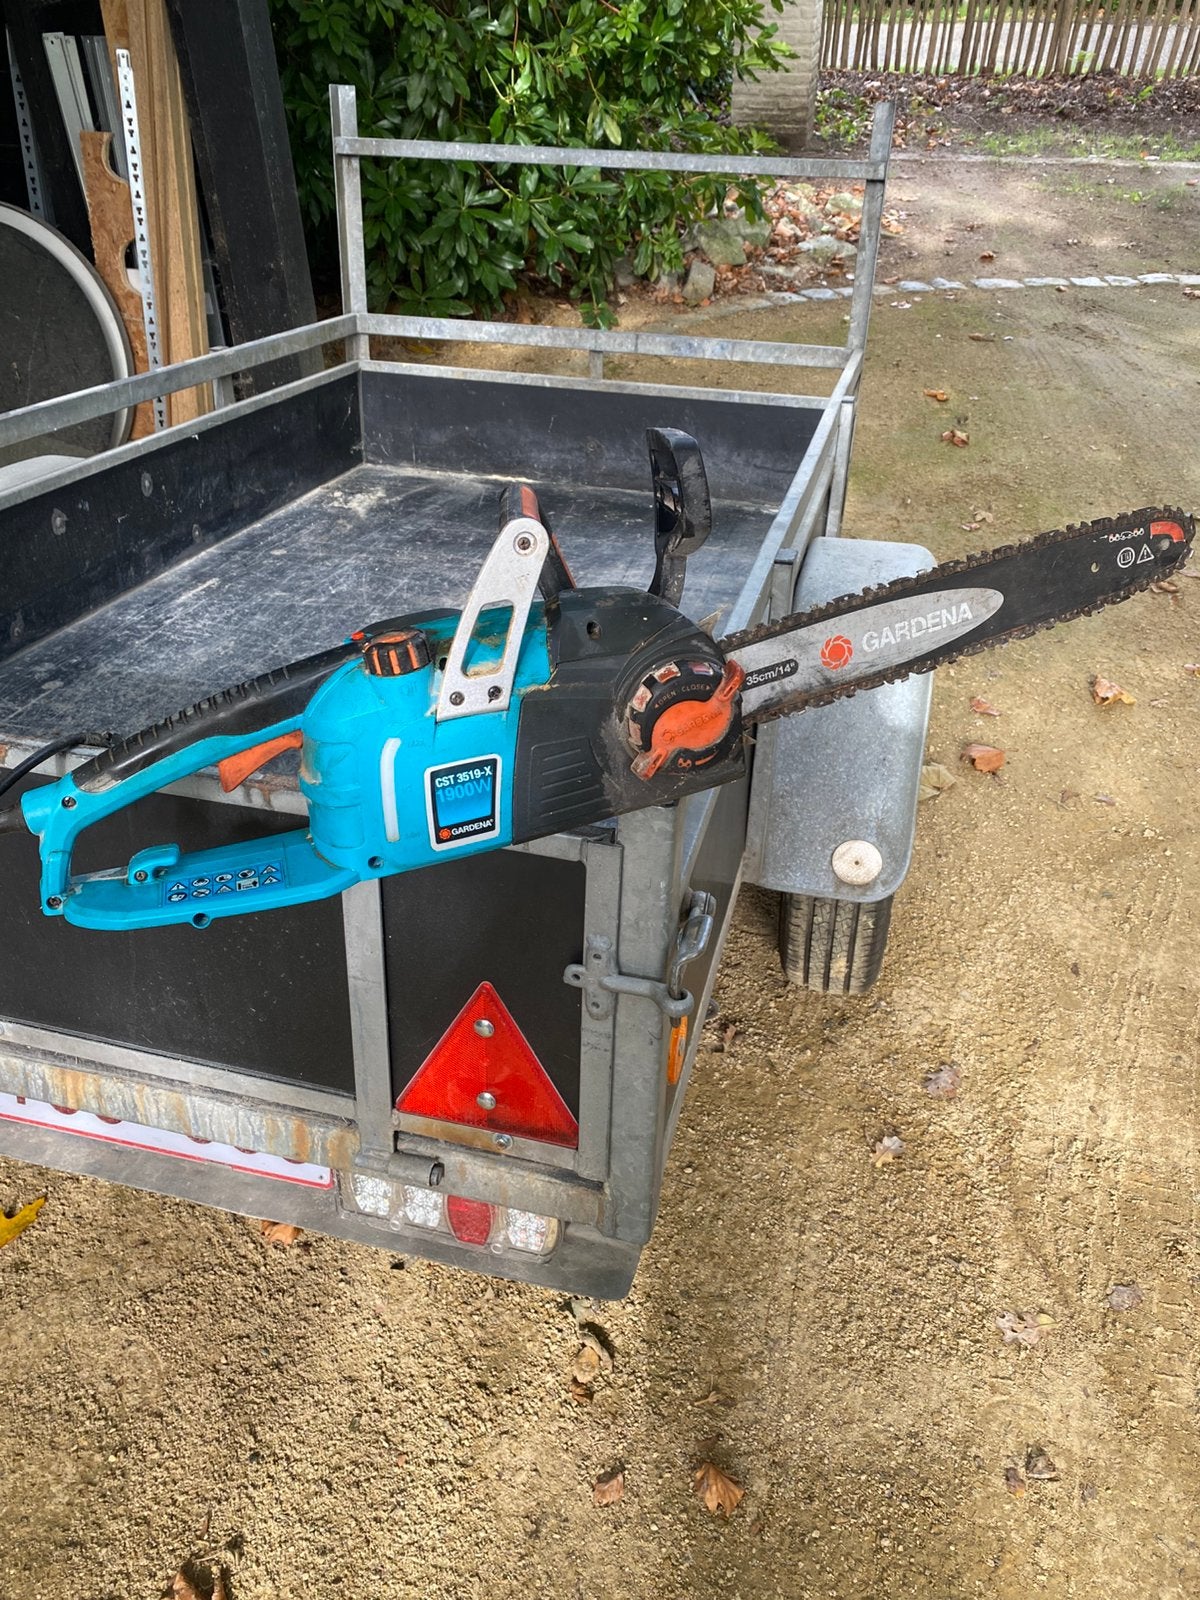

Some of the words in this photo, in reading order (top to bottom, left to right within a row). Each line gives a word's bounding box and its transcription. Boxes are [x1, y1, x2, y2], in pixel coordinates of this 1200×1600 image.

[862, 602, 974, 652] GARDENA
[435, 774, 455, 788] CST
[456, 765, 493, 783] 3519-X
[436, 776, 491, 803] 1900W
